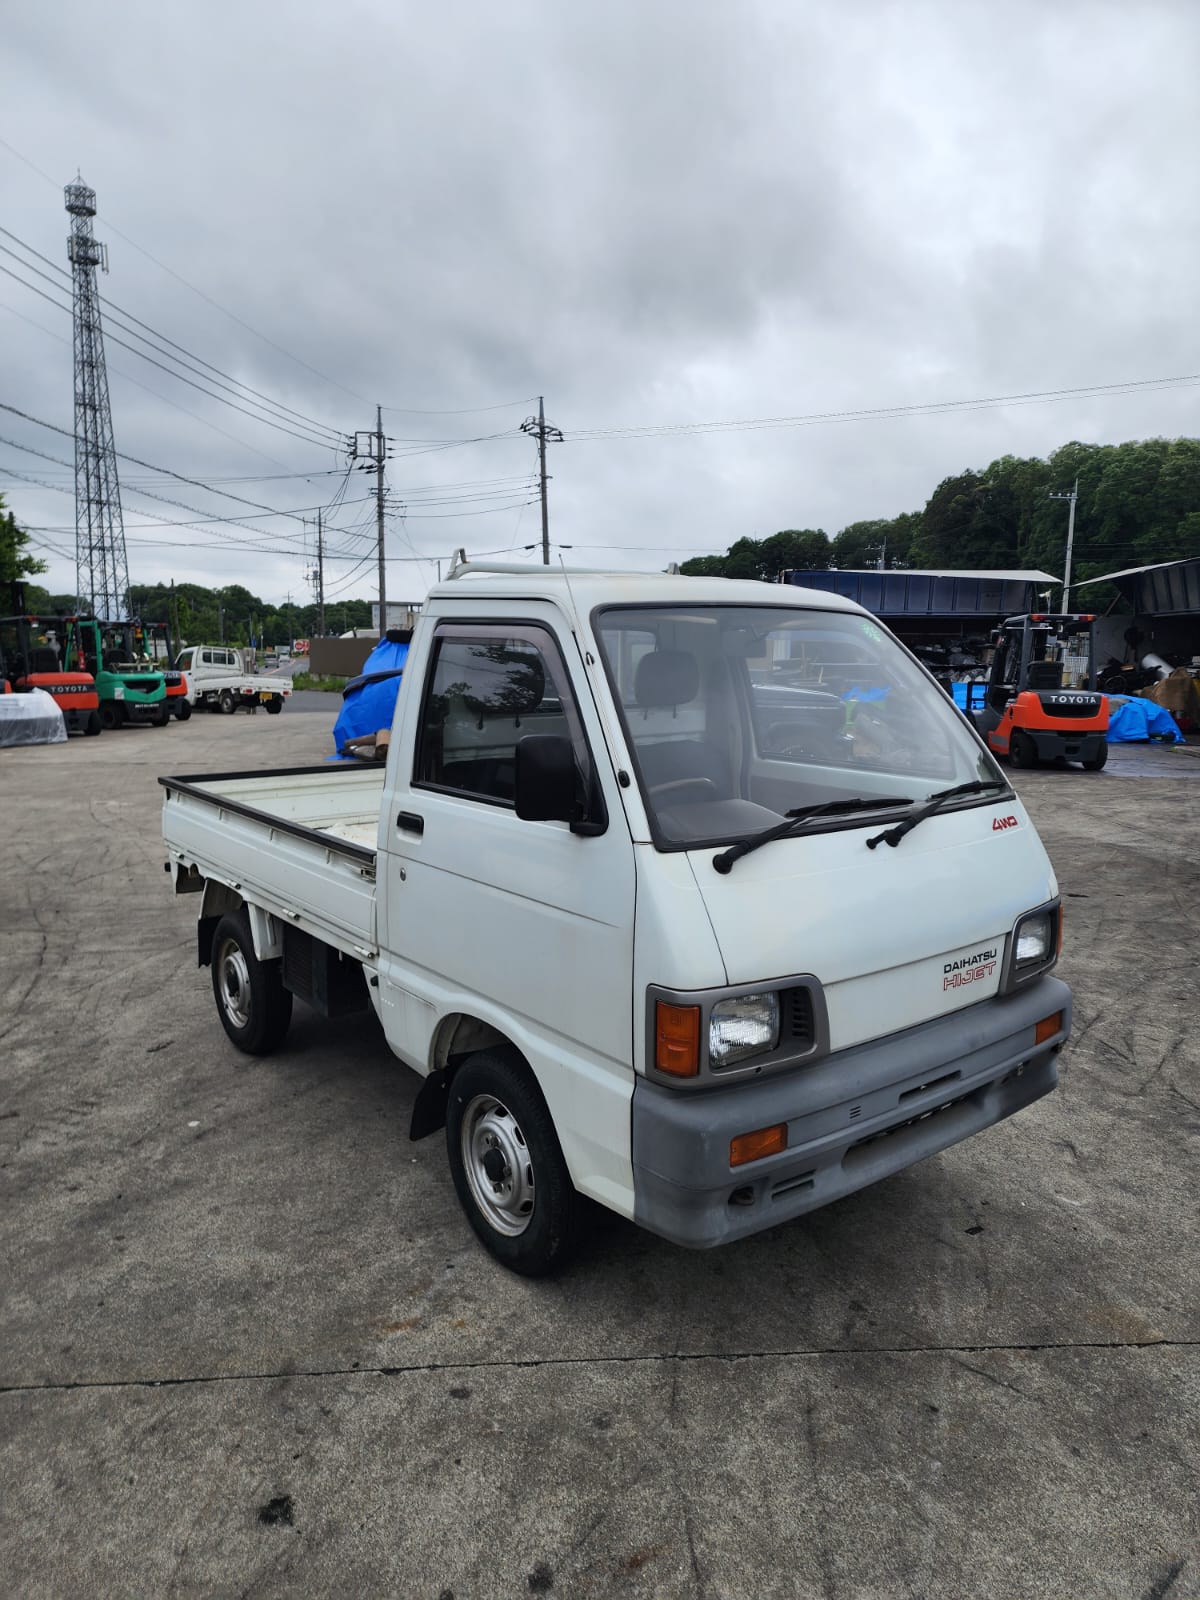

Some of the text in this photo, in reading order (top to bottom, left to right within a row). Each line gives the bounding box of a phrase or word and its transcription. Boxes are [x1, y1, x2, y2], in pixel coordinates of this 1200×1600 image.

[51, 685, 88, 693] TOYOTA
[1050, 695, 1097, 704] TOYOTA
[992, 815, 1019, 831] 4WD
[944, 948, 997, 974] DAIHATSU
[943, 960, 997, 991] HIJET
